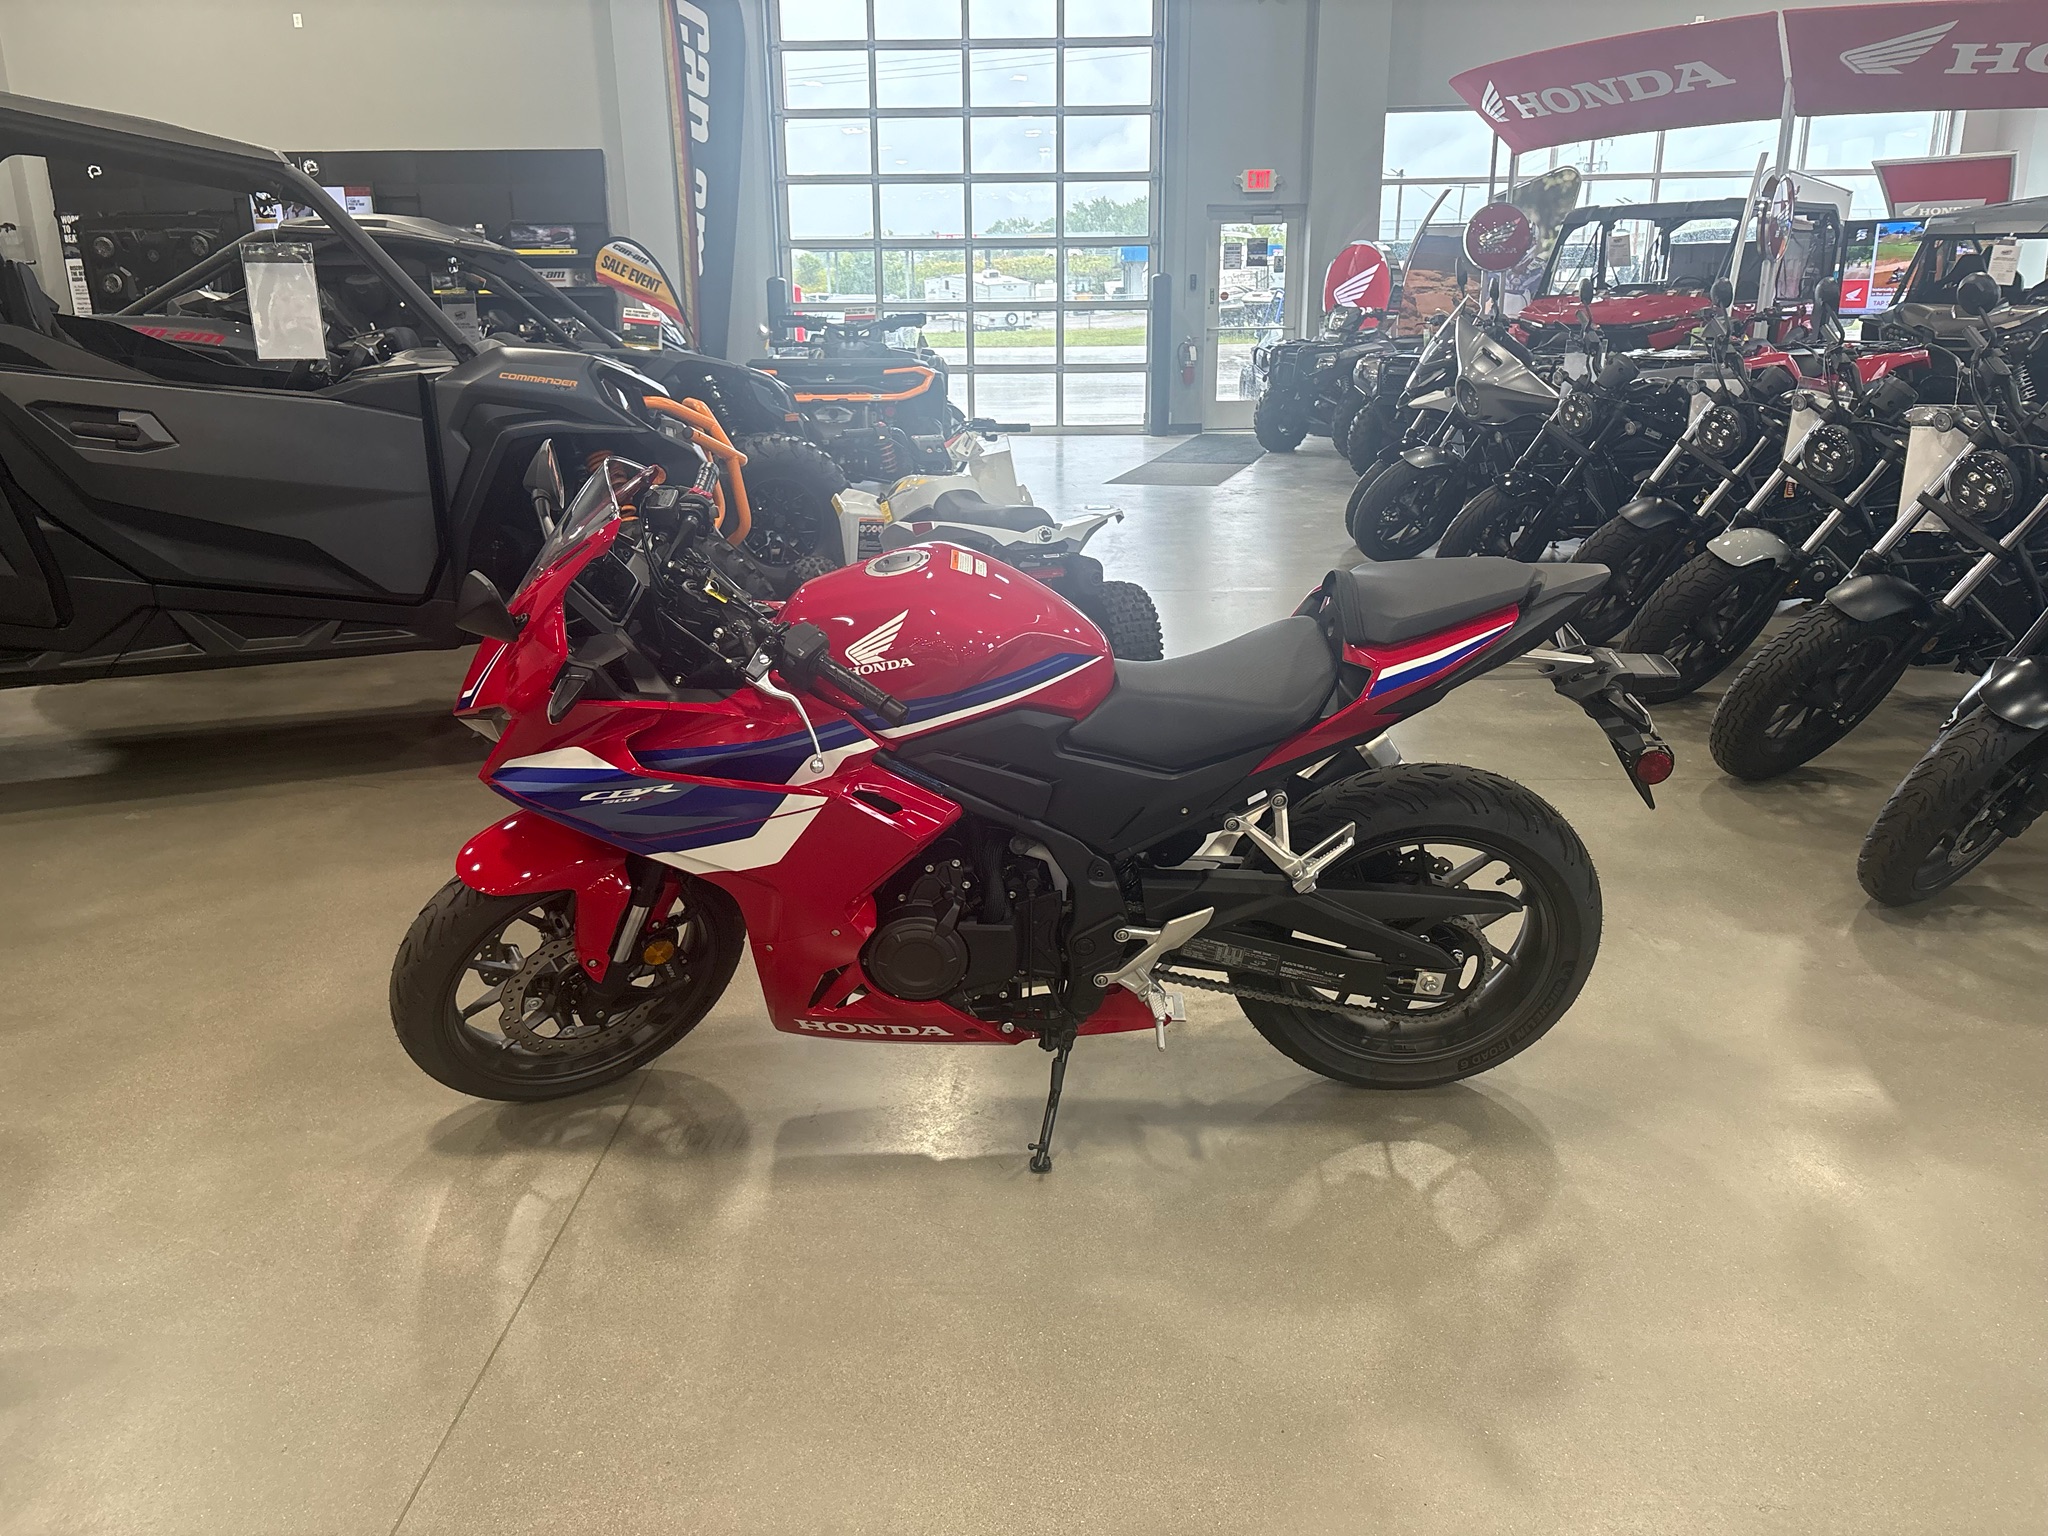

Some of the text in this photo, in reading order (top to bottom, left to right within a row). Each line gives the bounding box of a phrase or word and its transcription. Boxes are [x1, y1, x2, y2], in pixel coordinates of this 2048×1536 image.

[1506, 61, 1736, 119] HONDA
[1247, 170, 1271, 189] EXIT
[1918, 205, 1972, 216] HON
[61, 224, 71, 234] TO
[63, 234, 78, 243] BEA
[612, 243, 650, 265] can-am
[601, 255, 662, 292] SALE EVENT
[499, 372, 578, 387] COMMANDER
[848, 657, 915, 676] HONDA
[580, 783, 681, 802] CBR
[793, 1018, 955, 1036] HONDA
[1471, 1042, 1509, 1064] ROAD
